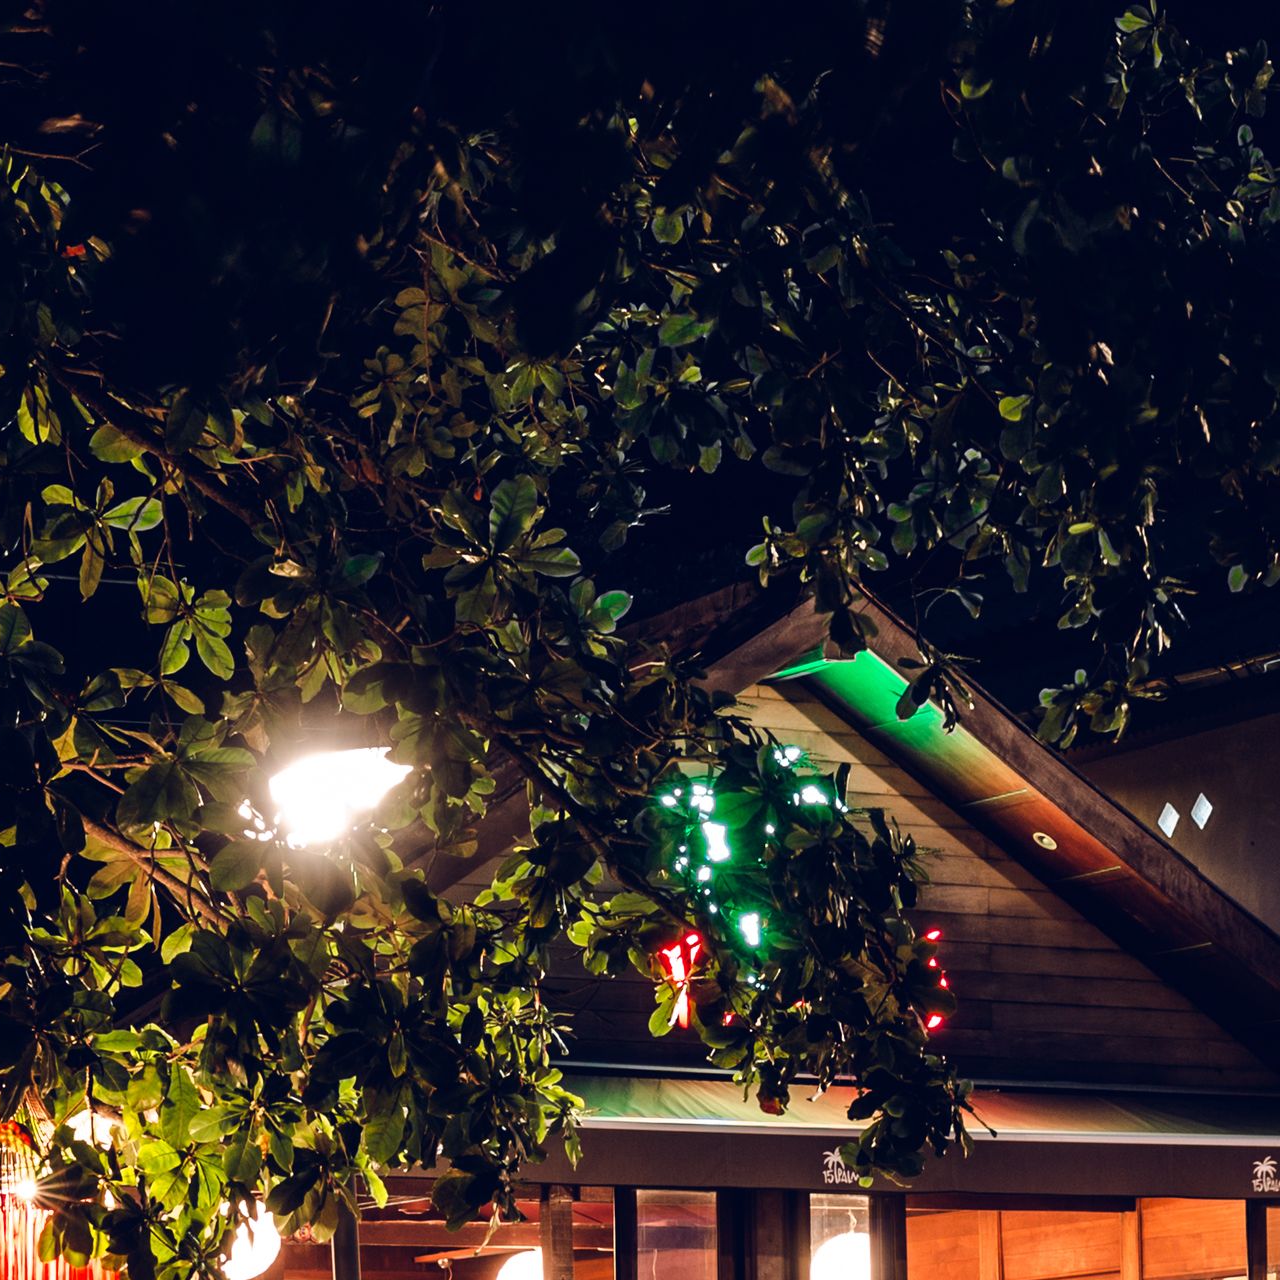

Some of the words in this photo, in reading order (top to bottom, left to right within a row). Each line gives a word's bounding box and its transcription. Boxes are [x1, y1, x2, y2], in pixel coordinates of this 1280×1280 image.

[822, 1170, 834, 1184] 15
[834, 1167, 860, 1184] PALM
[1252, 1179, 1264, 1192] 15
